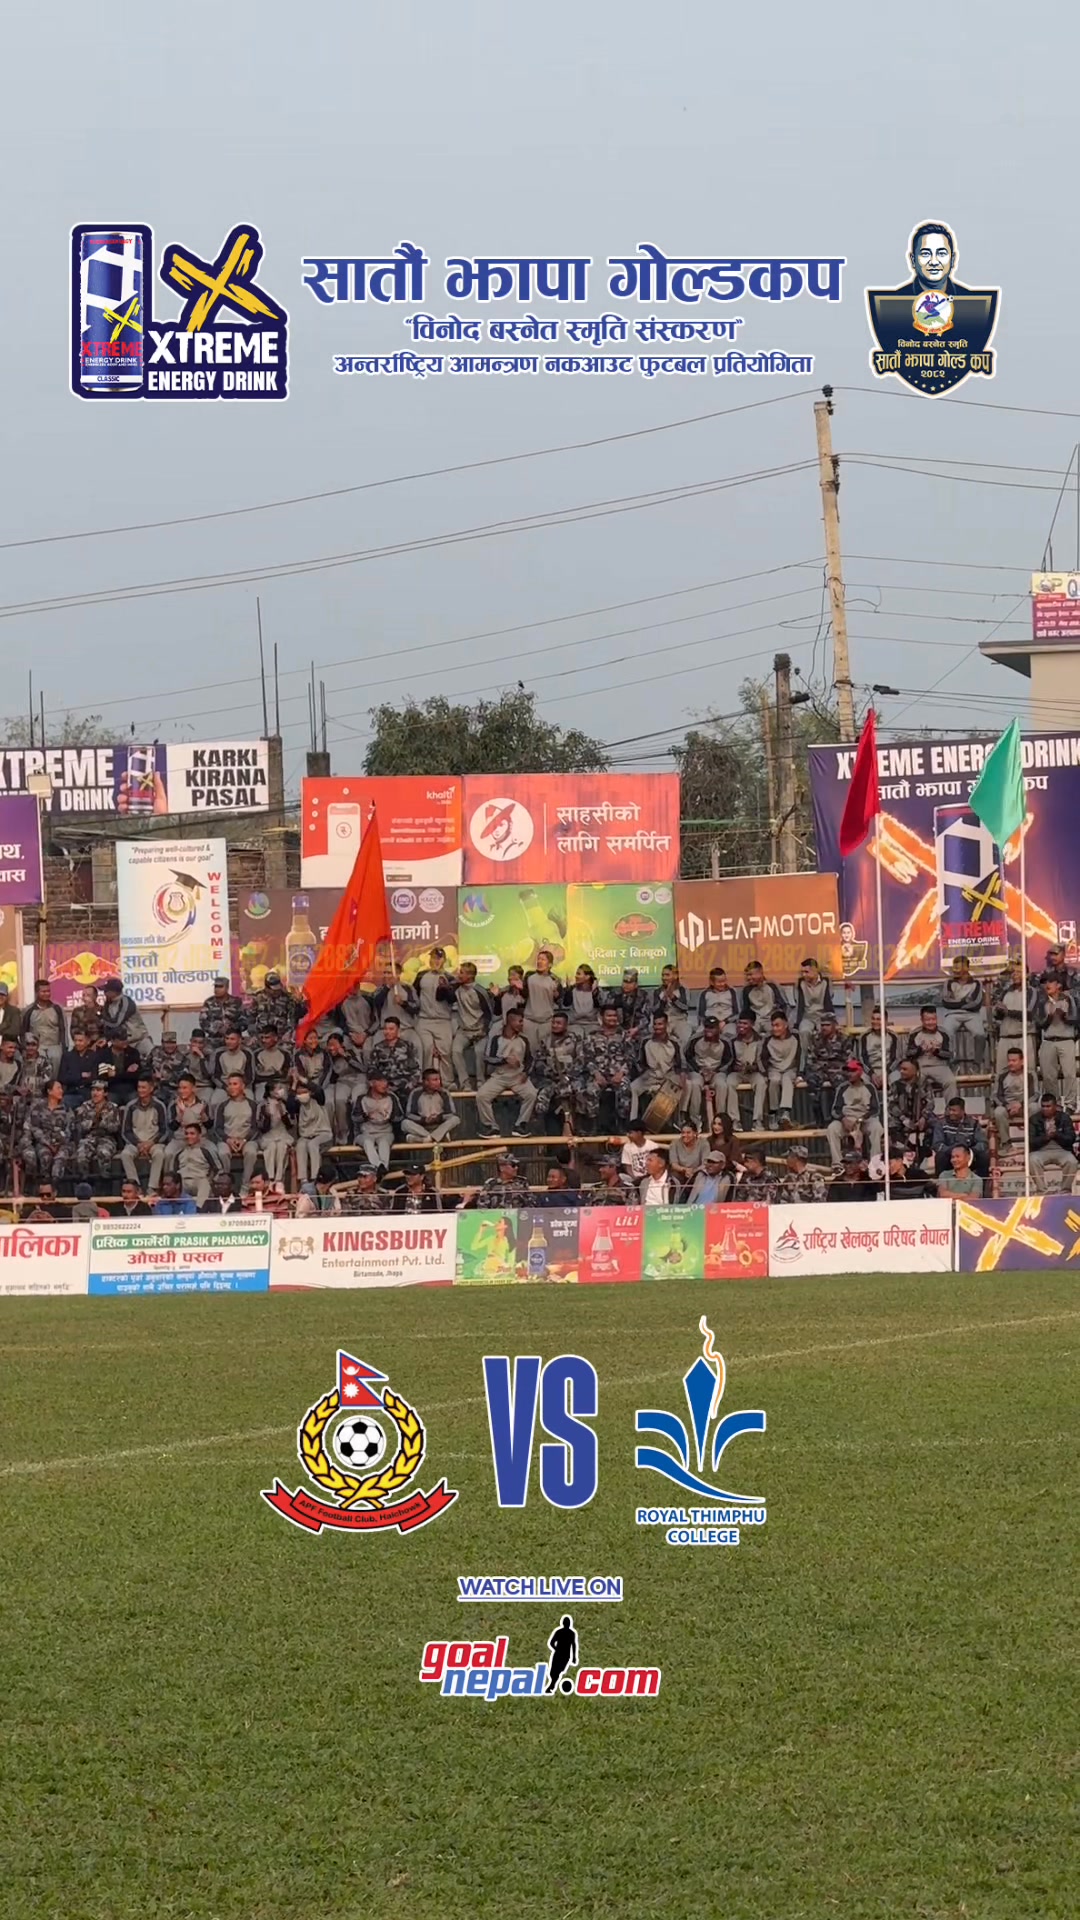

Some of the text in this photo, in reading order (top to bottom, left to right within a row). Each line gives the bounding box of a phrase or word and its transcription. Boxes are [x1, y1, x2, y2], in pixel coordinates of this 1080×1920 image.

[193, 749, 258, 768] KARKI
[185, 767, 267, 788] KIRANA
[61, 785, 115, 812] DRINK
[191, 787, 262, 807] PASAL
[916, 781, 962, 797] झापा
[556, 801, 642, 822] साहसीको
[556, 832, 672, 854] लागि समर्पित
[707, 912, 836, 942] LEAPMOTOR
[123, 972, 158, 985] झापा
[173, 1234, 265, 1247] PRASIK PHARMACY
[323, 1229, 448, 1253] KINGSBURY
[803, 1223, 950, 1254] राष्ट्रिय खेलकुद परिषद नेपाल
[127, 1250, 224, 1265] औषधी पसल
[321, 1254, 446, 1269] Entertainment Pvt. Ltd.
